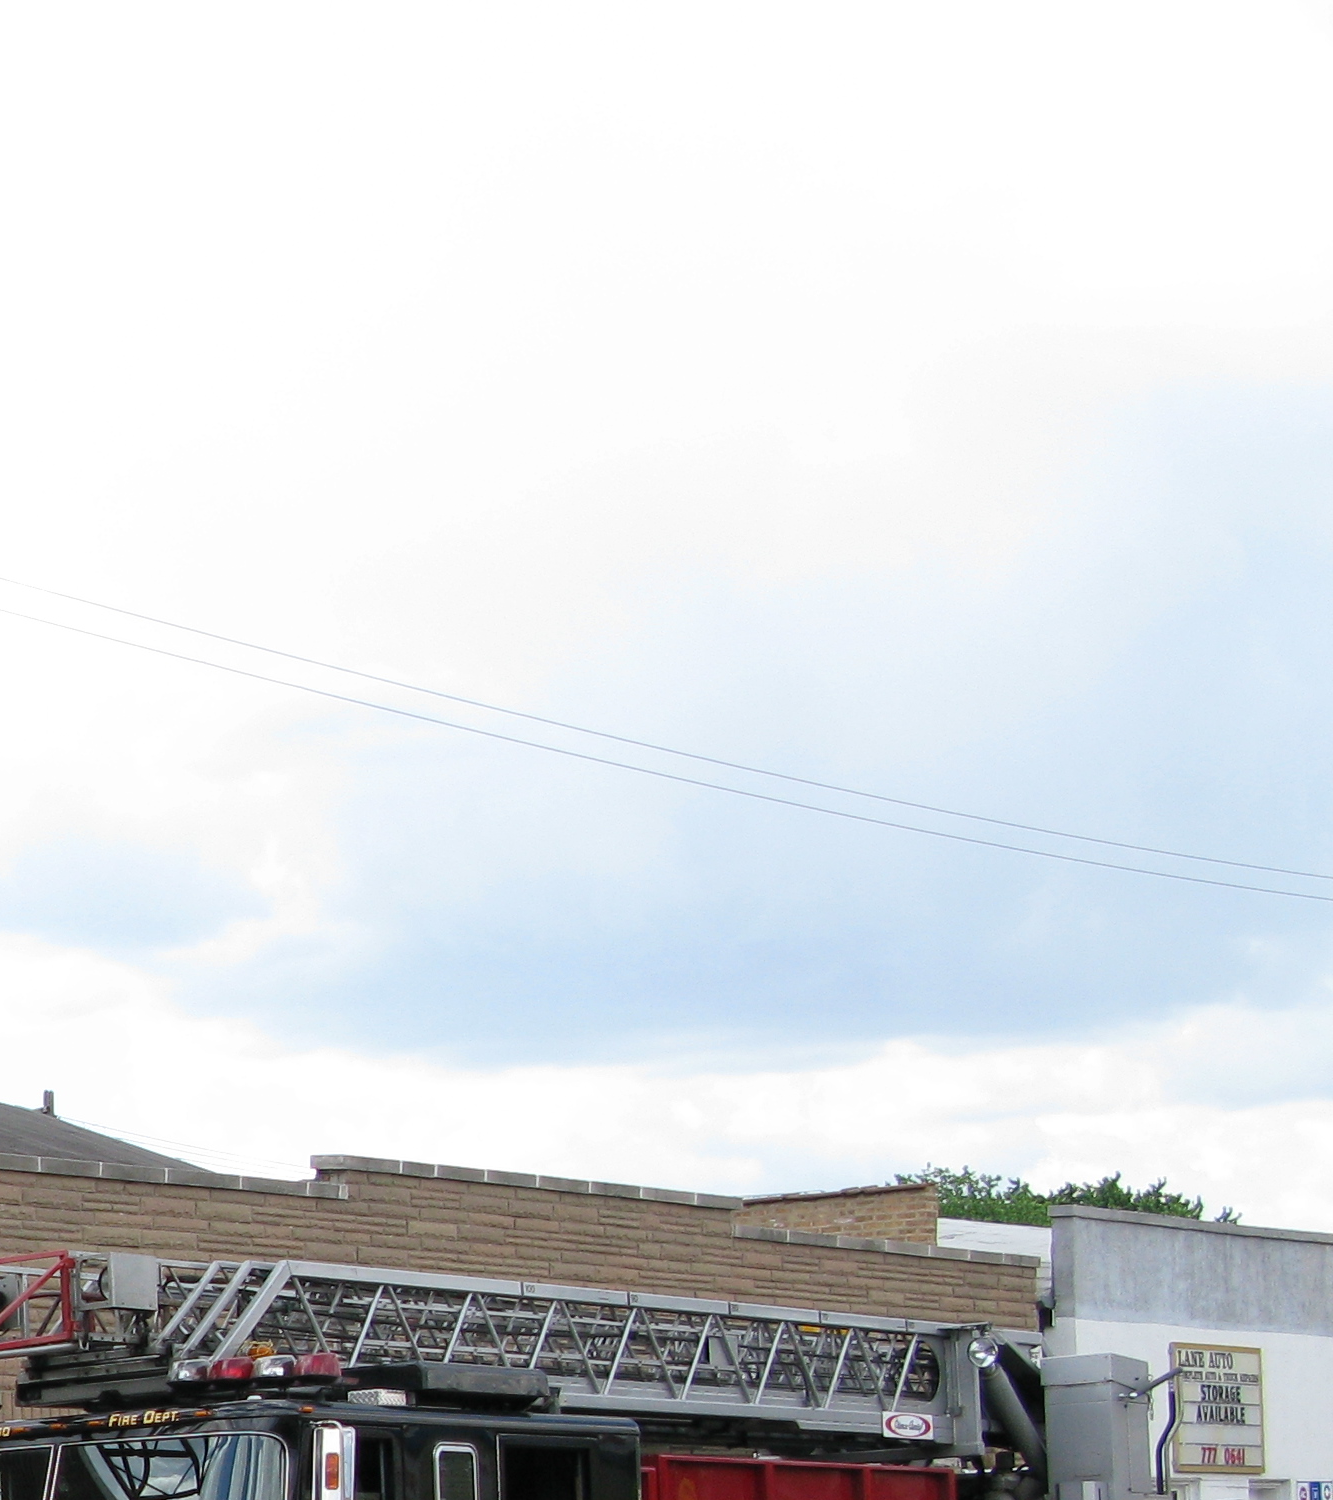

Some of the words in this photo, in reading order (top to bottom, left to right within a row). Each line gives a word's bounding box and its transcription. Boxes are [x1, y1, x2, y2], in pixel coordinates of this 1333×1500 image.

[1177, 1350, 1205, 1368] LANE
[1208, 1352, 1234, 1370] AUTO
[1200, 1384, 1242, 1404] STORAGE
[108, 1412, 137, 1427] FIRE
[143, 1410, 180, 1424] DEPT.
[1195, 1405, 1246, 1425] AVAILABLE
[1201, 1446, 1217, 1464] 777
[1224, 1447, 1246, 1465] 0641
